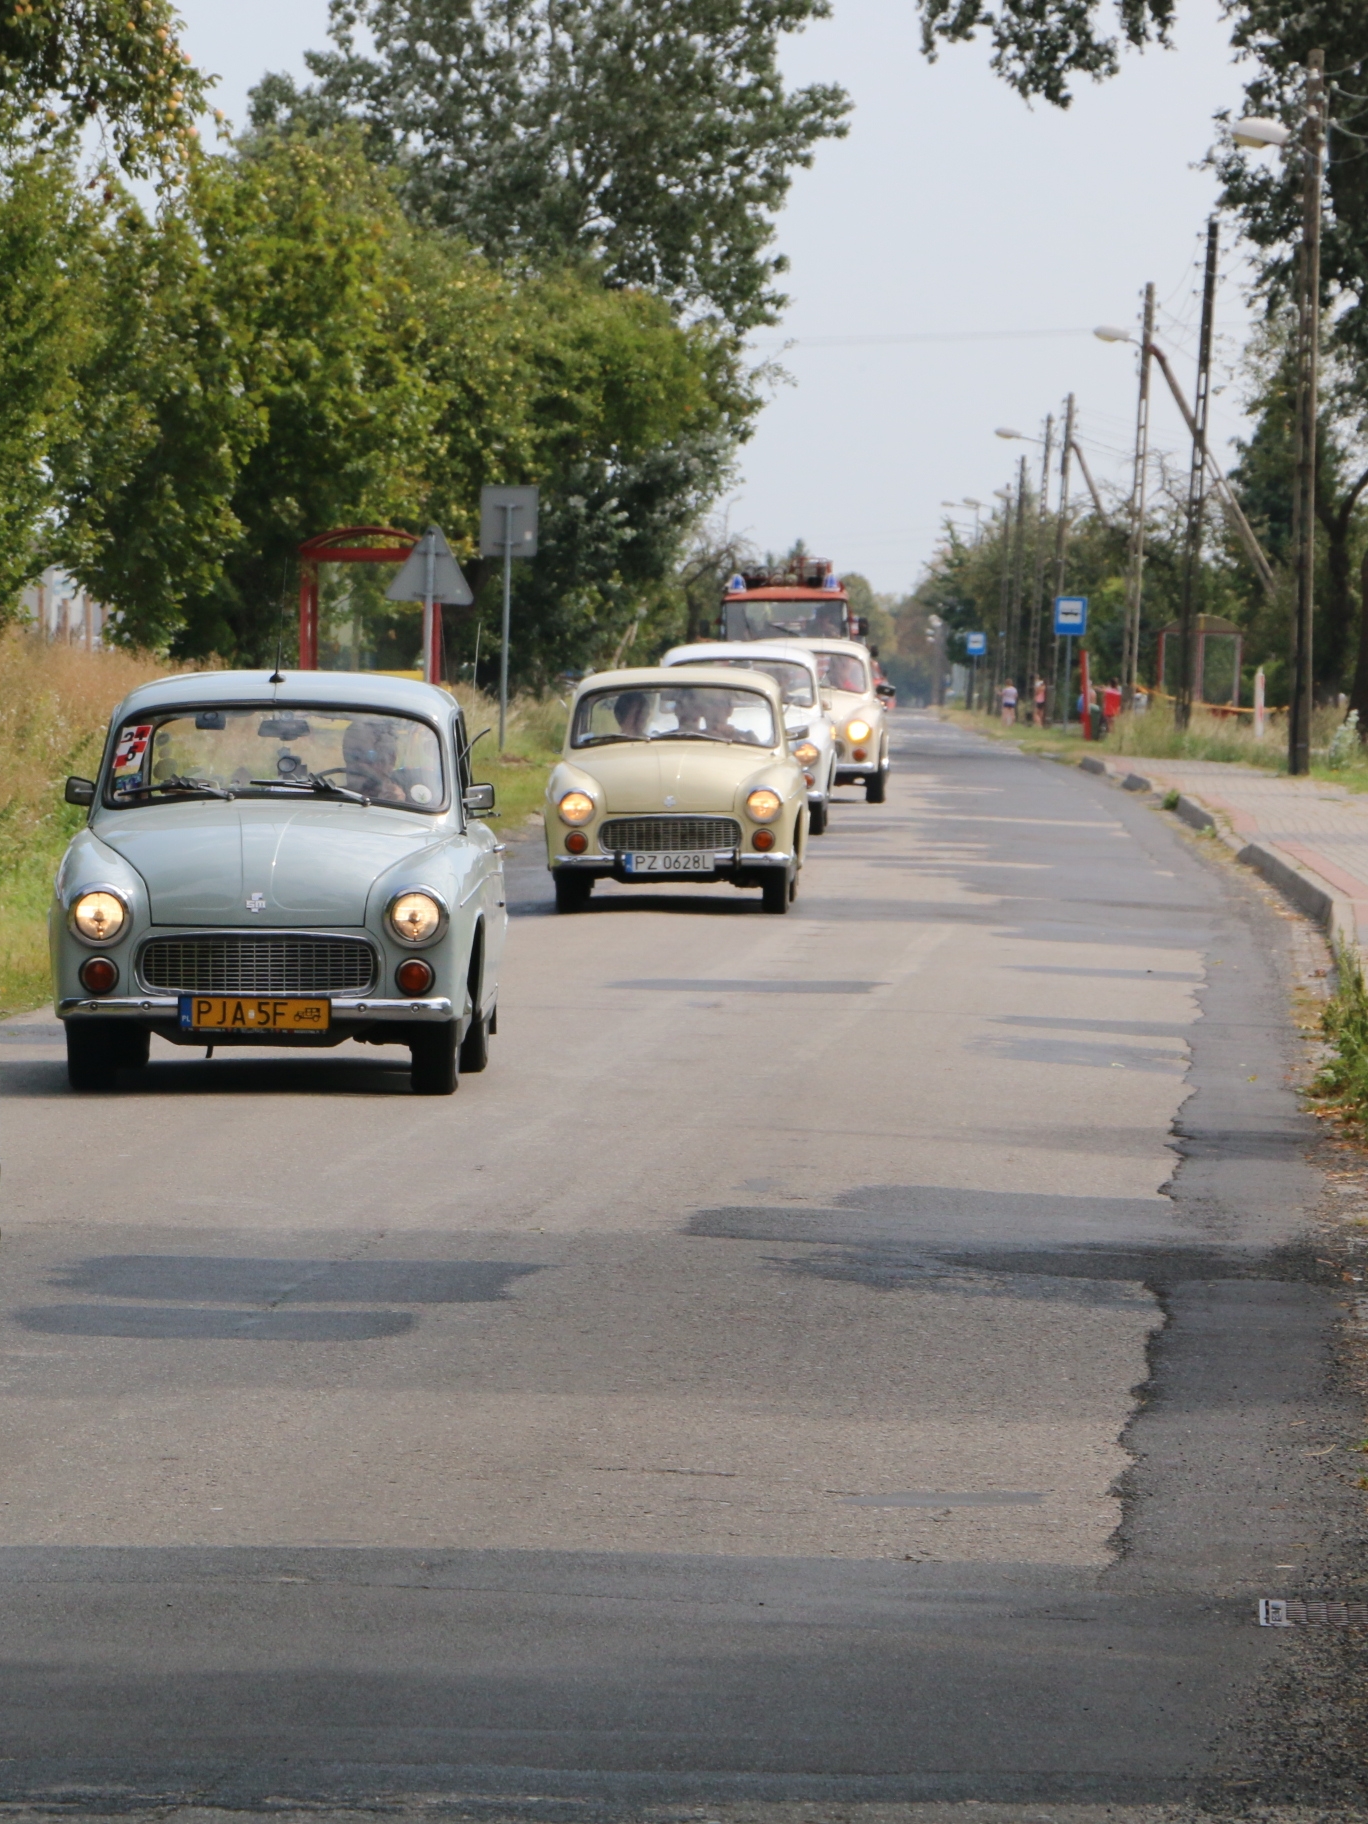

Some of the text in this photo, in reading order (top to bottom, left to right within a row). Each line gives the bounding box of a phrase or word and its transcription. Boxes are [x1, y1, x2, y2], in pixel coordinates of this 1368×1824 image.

[127, 745, 138, 762] 5
[635, 855, 710, 870] PZ 0628L
[196, 1000, 288, 1026] PJA 5F
